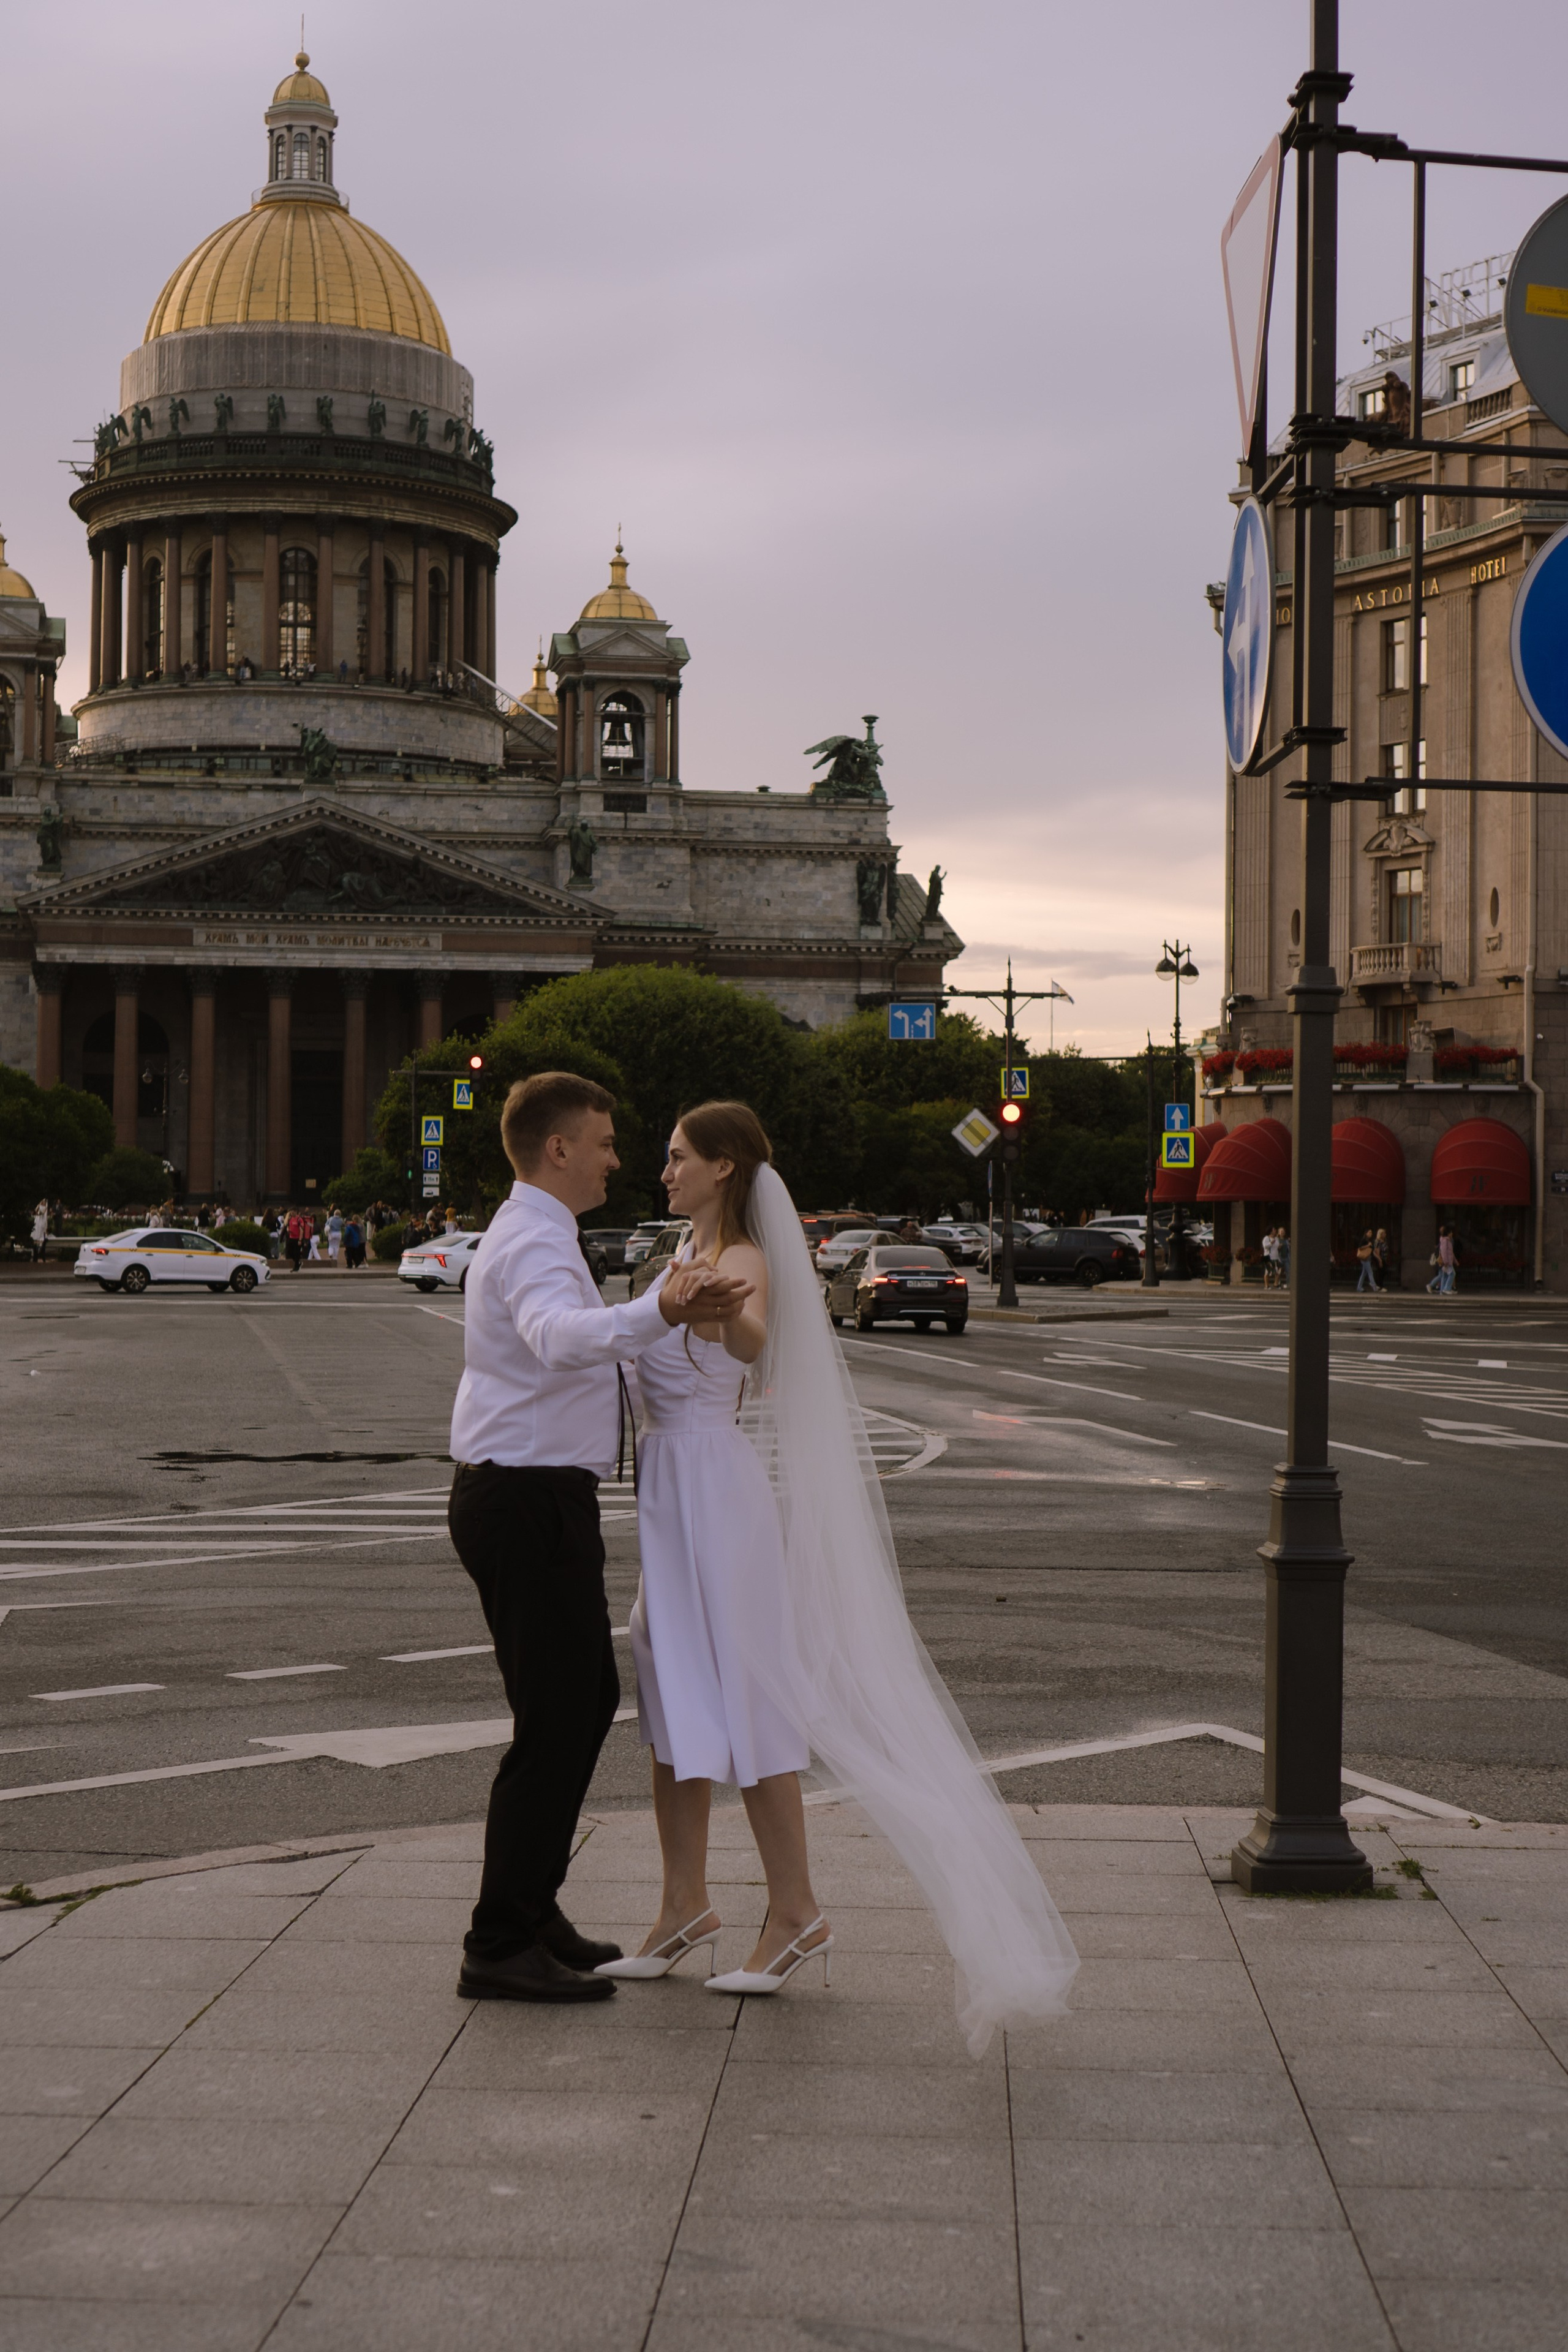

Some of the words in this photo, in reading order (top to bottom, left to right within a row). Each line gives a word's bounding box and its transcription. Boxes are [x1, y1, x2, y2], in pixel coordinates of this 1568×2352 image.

[1471, 556, 1507, 584] HOTEL
[205, 932, 238, 943] ХРАМЪ
[276, 933, 309, 945] ХРАМЪ
[428, 1151, 437, 1167] P
